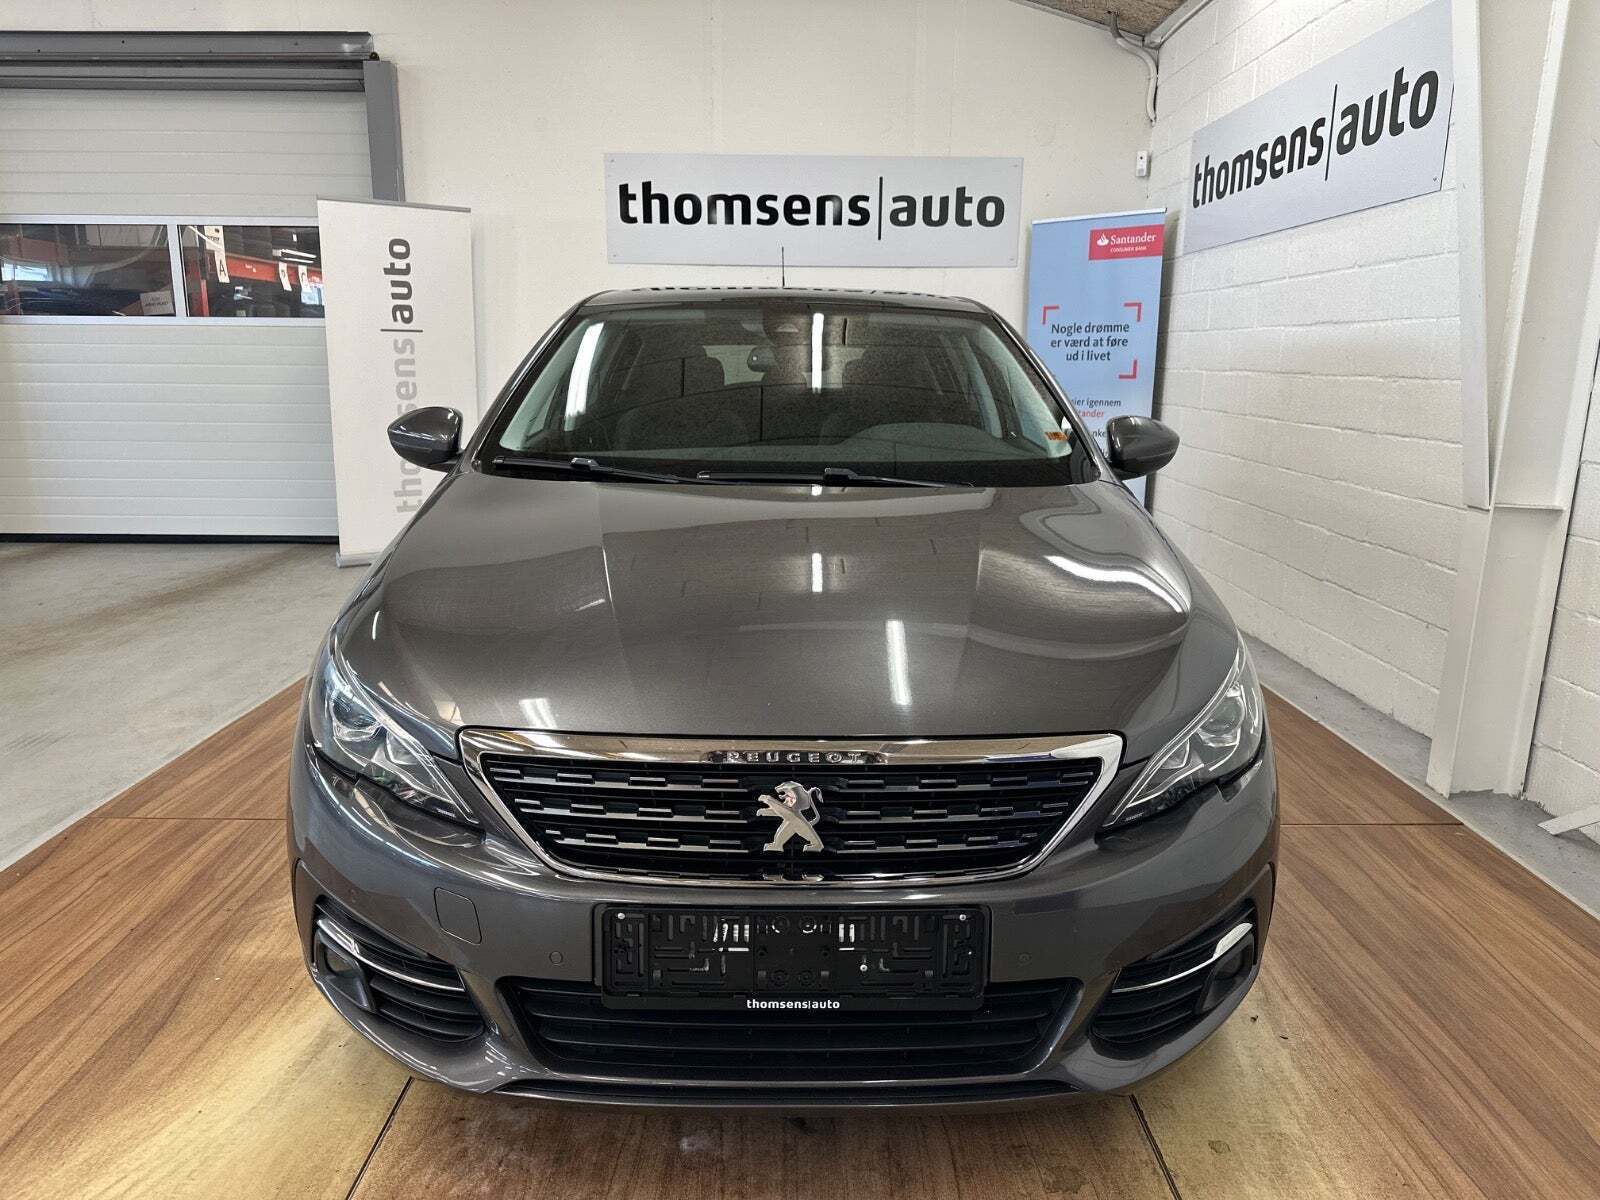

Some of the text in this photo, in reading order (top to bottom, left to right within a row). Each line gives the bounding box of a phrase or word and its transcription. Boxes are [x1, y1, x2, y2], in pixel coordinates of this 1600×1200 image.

[1110, 232, 1157, 245] Santander
[1051, 322, 1130, 336] Nogle drømme
[1050, 336, 1128, 348] er værd at føre
[1066, 351, 1079, 361] ud
[1086, 351, 1111, 361] livet
[1086, 397, 1122, 408] igennem
[726, 751, 862, 764] PEUGEOT
